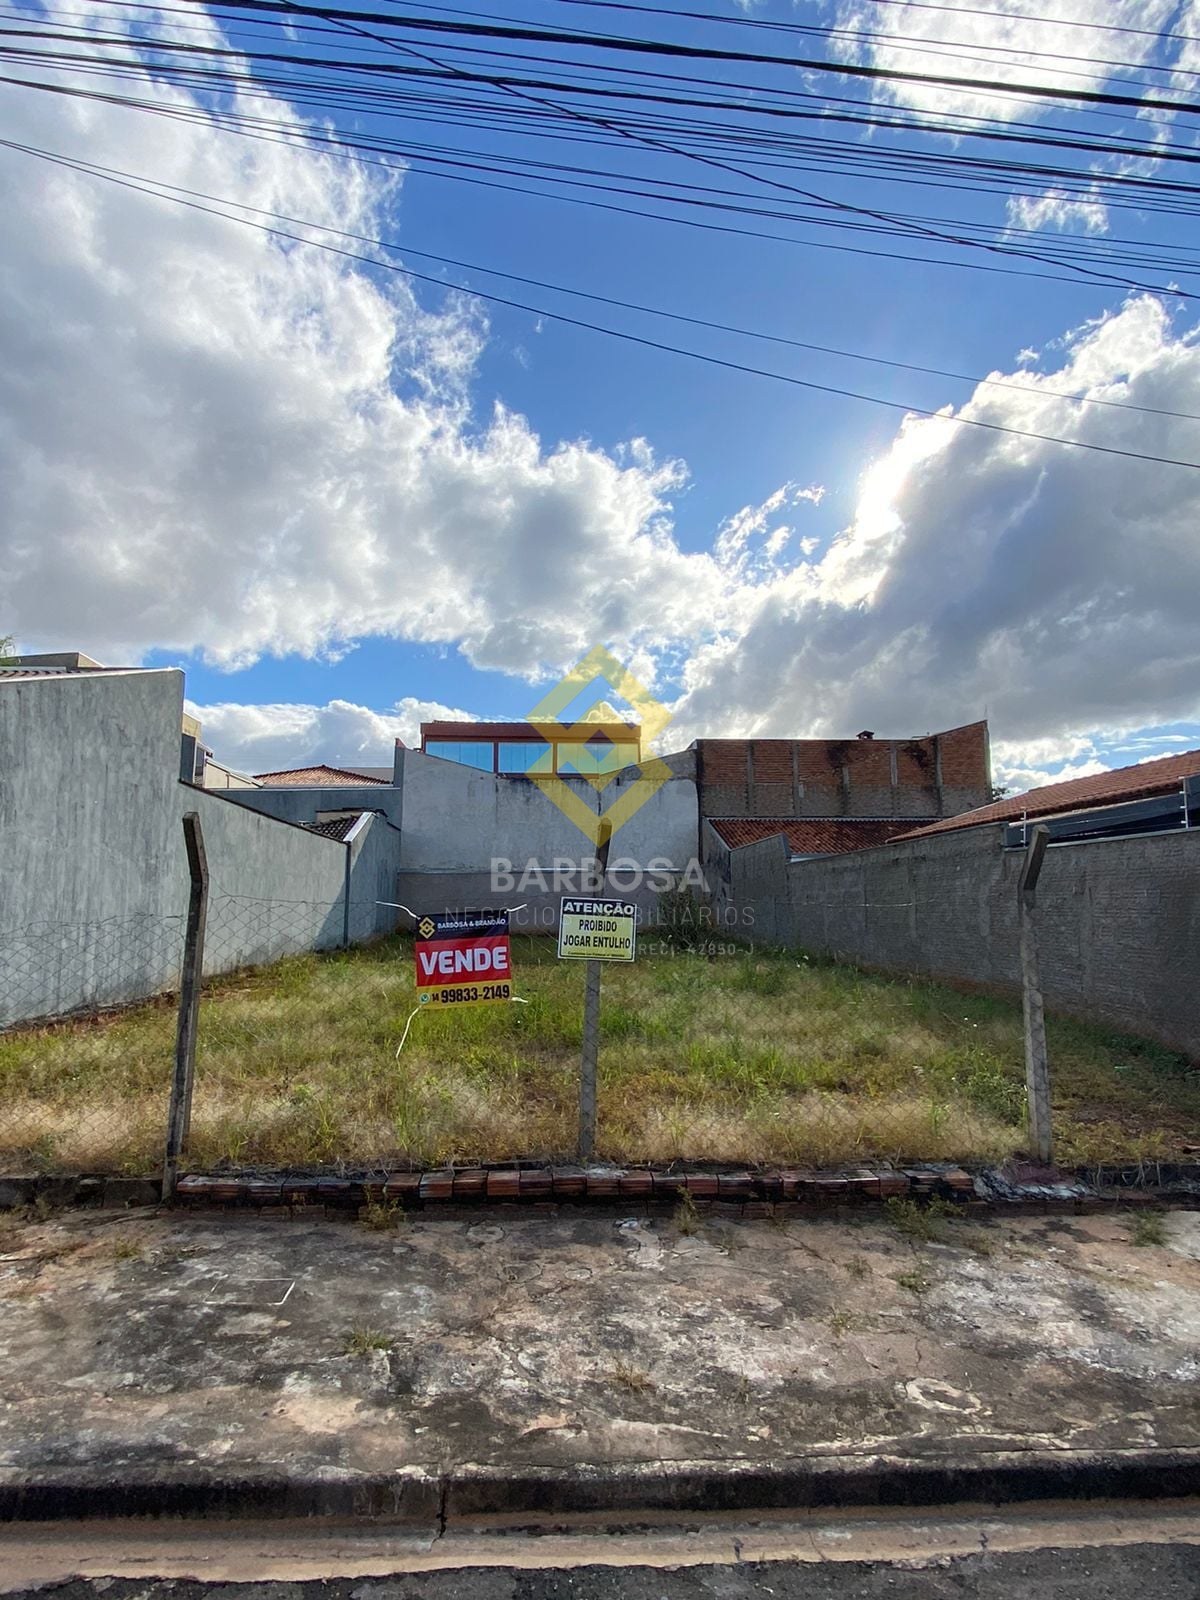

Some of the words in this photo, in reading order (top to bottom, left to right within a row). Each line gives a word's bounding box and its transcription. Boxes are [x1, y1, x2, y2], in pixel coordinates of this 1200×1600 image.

[564, 902, 634, 916] ATENÇÃO
[437, 921, 468, 930] BARBOSA
[579, 919, 617, 932] PROIBIDO
[563, 934, 591, 947] JOGAR
[593, 936, 631, 949] ENTULHO
[419, 946, 508, 975] VENDE
[432, 993, 440, 1001] 14
[441, 985, 510, 1003] 99833-2149
